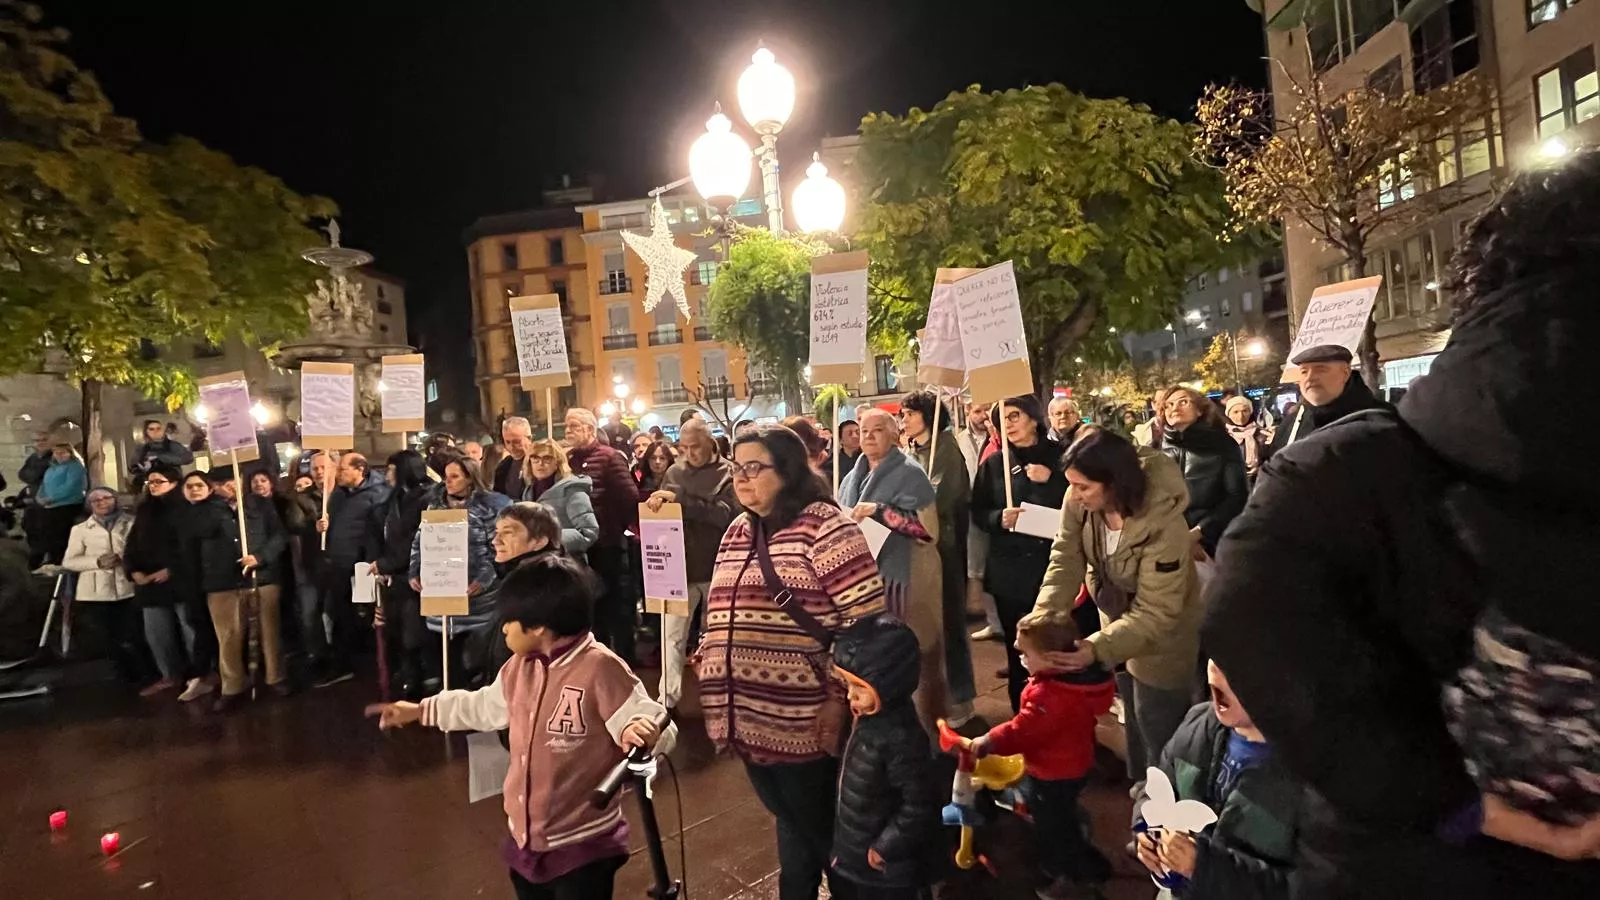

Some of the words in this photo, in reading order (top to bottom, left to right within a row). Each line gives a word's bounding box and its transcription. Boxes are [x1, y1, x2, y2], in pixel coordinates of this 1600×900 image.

[815, 281, 849, 296] Violencia
[1310, 300, 1354, 314] Querer
[546, 684, 588, 736] A
